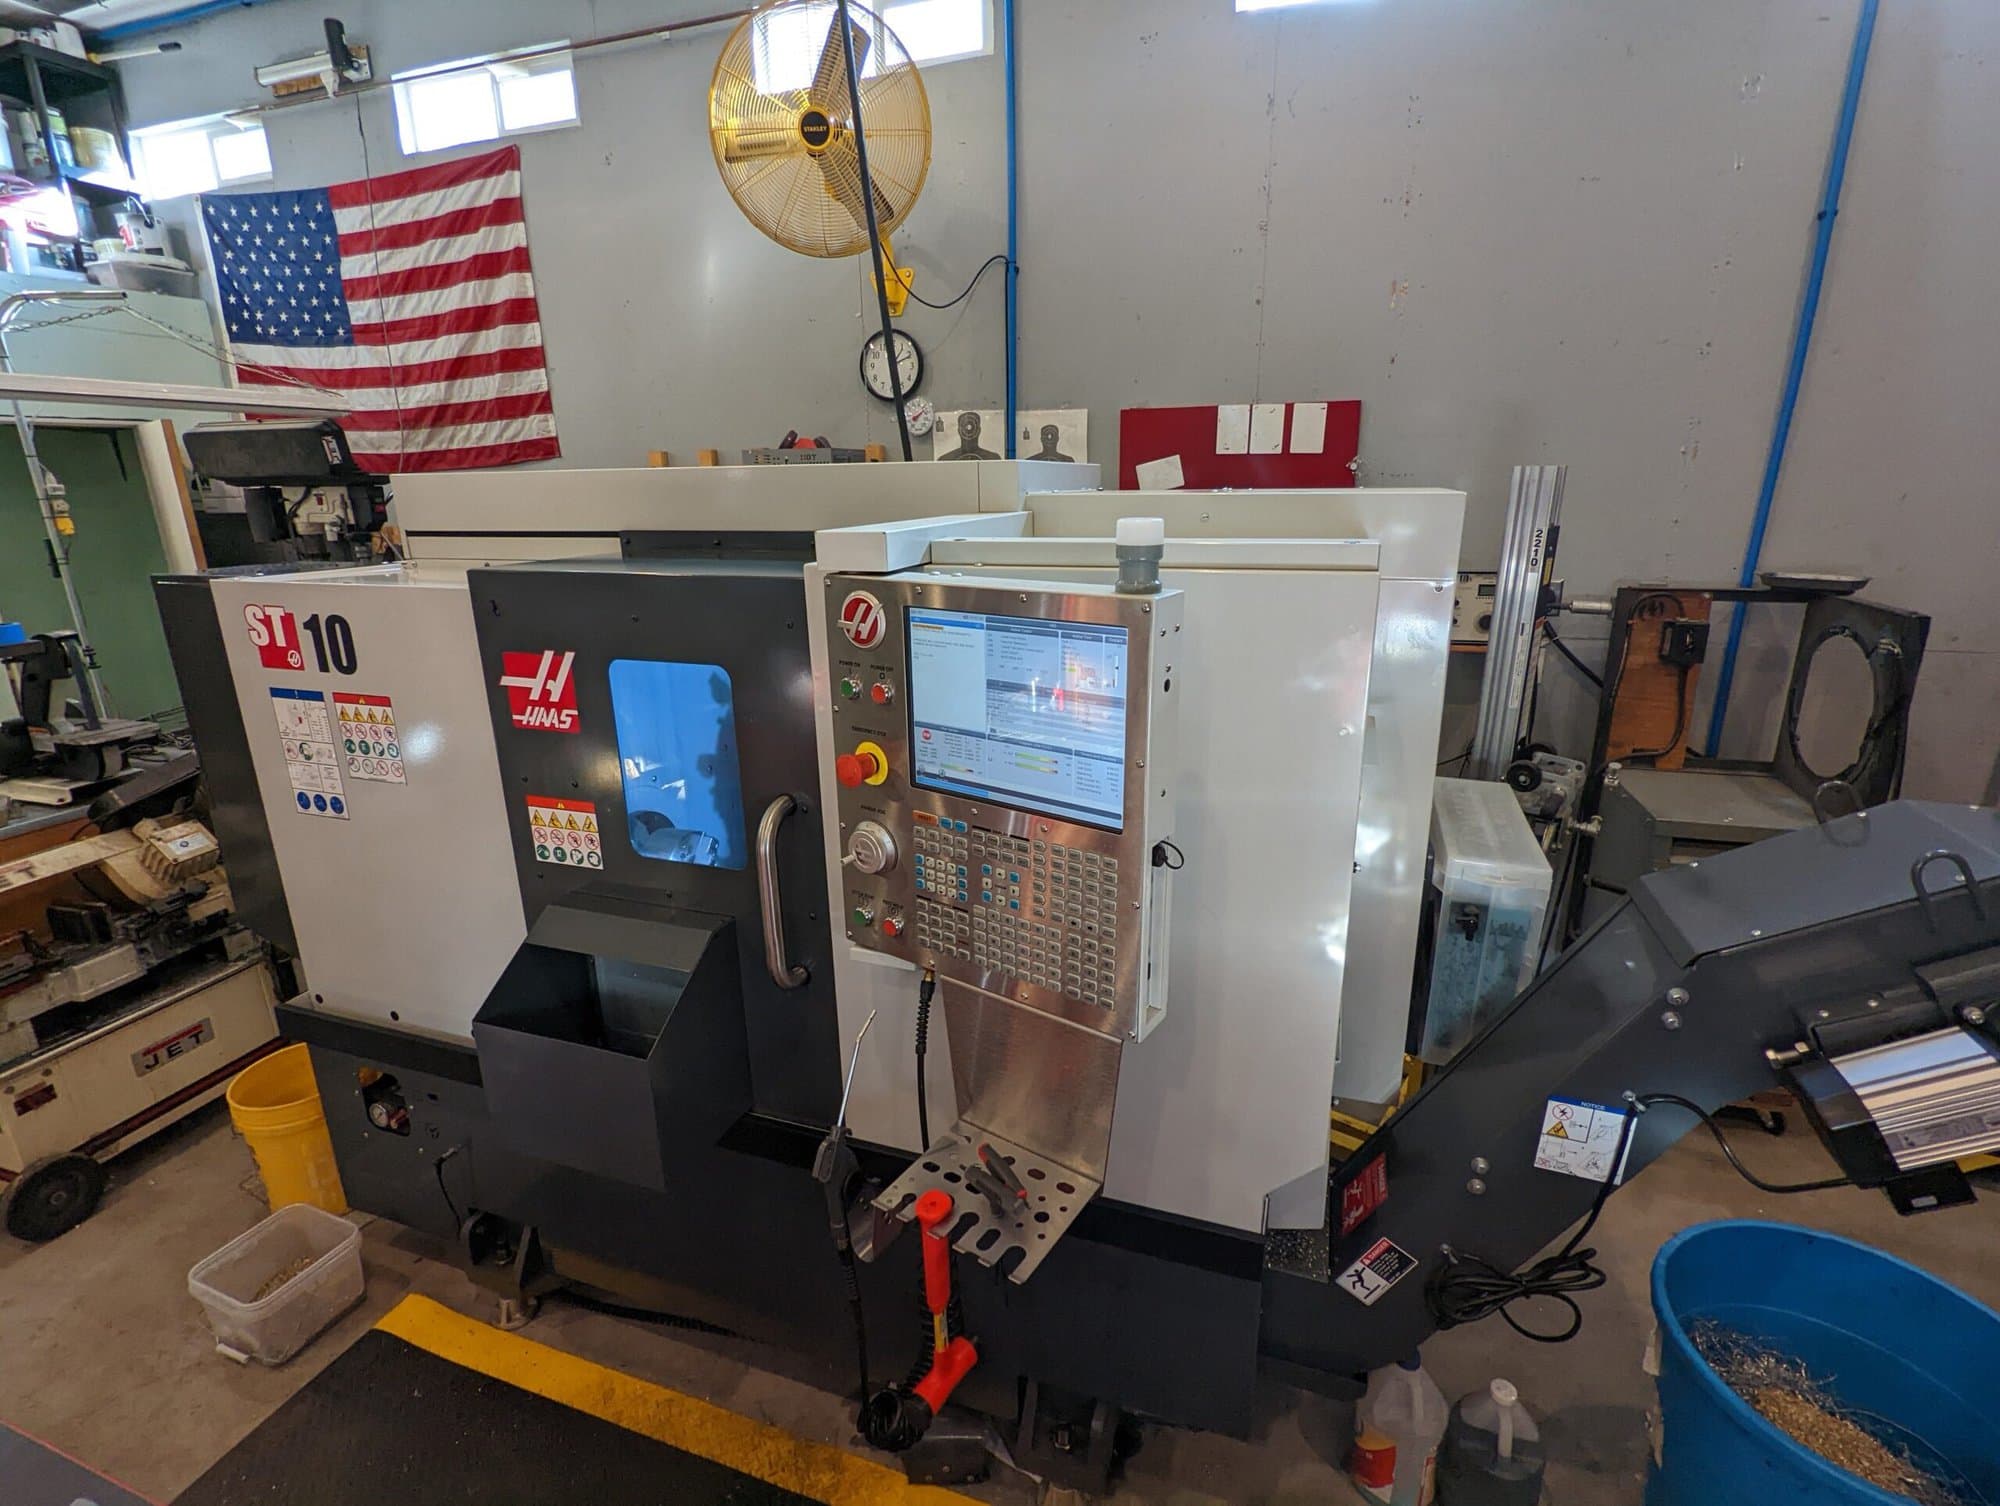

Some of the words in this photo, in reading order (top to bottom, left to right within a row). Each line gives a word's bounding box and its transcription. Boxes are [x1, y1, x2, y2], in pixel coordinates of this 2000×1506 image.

[1530, 529, 1544, 567] 2210
[243, 604, 287, 648] ST
[302, 613, 358, 676] 10
[511, 705, 579, 730] HAAS
[144, 1032, 204, 1070] JET
[1580, 1101, 1606, 1111] NOTICE
